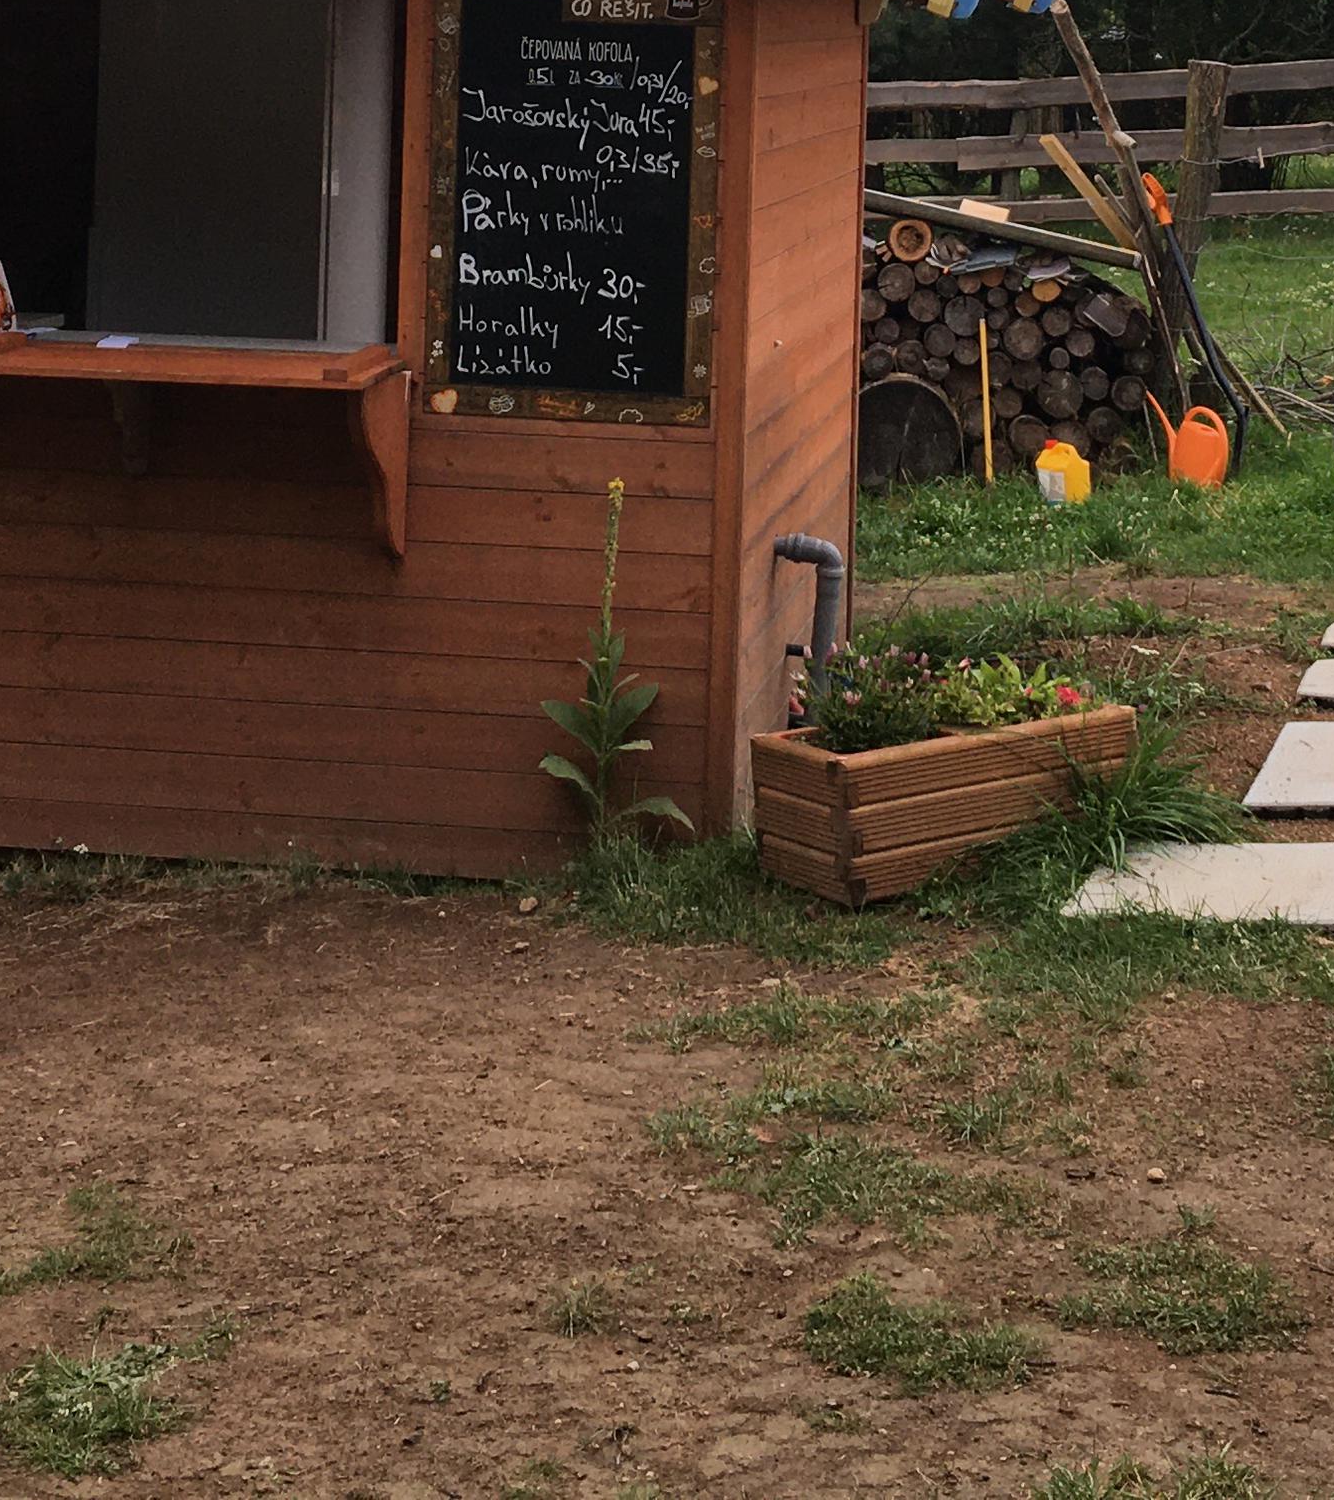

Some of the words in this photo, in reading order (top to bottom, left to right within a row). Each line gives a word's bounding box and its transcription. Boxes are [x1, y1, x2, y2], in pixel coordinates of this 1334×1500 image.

[520, 36, 583, 61] ČEPOVANÁ
[568, 69, 581, 85] ZA
[462, 87, 590, 150] Jarošovský
[539, 213, 549, 232] v
[458, 303, 559, 349] Horalky
